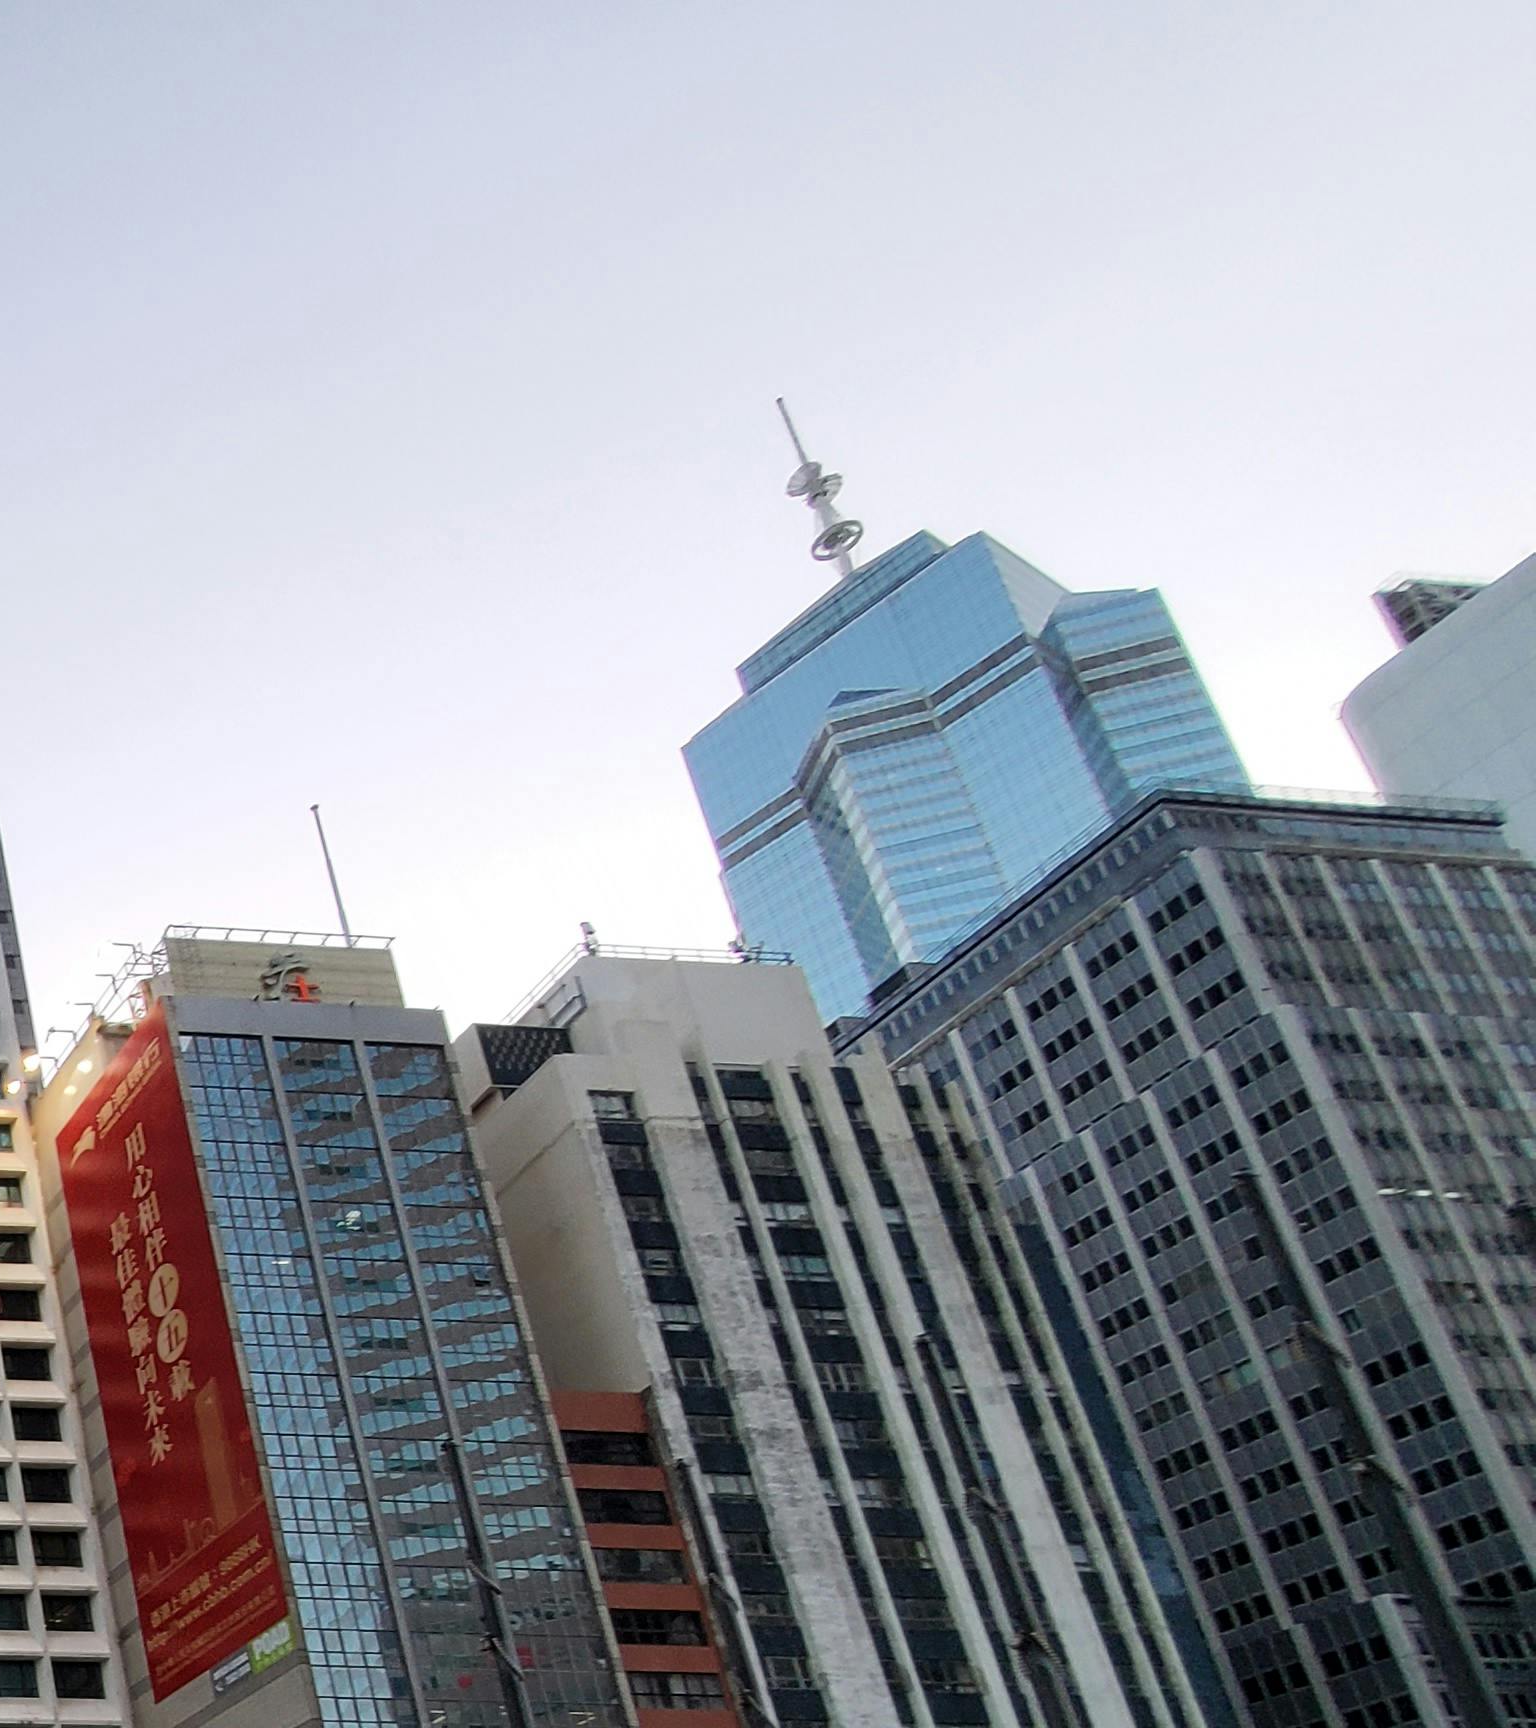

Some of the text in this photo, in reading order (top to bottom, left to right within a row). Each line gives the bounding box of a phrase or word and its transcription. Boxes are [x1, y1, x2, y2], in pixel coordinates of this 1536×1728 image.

[124, 1122, 195, 1401] 用心相伴十五載
